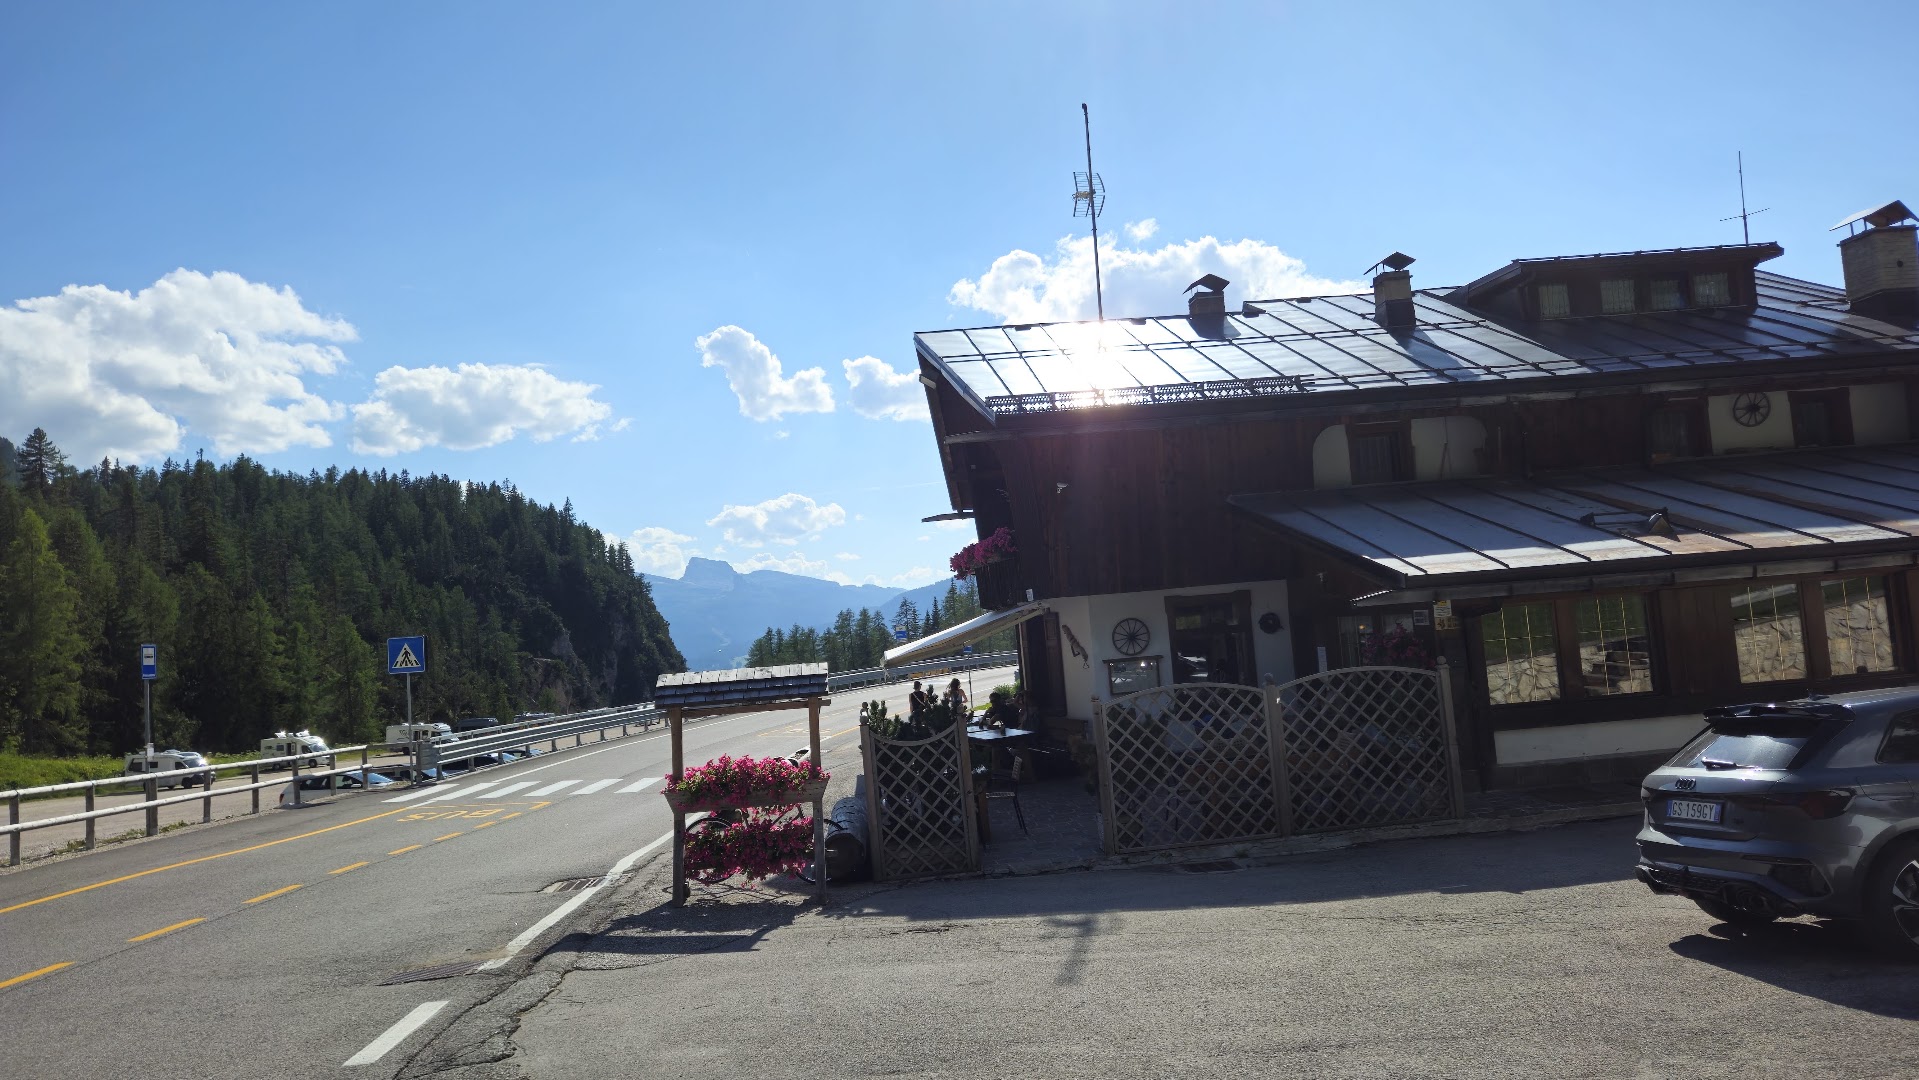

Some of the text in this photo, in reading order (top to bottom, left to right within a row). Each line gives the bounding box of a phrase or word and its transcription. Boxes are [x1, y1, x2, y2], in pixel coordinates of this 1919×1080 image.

[397, 808, 505, 822] BUS
[1672, 801, 1714, 819] GS 159GY
